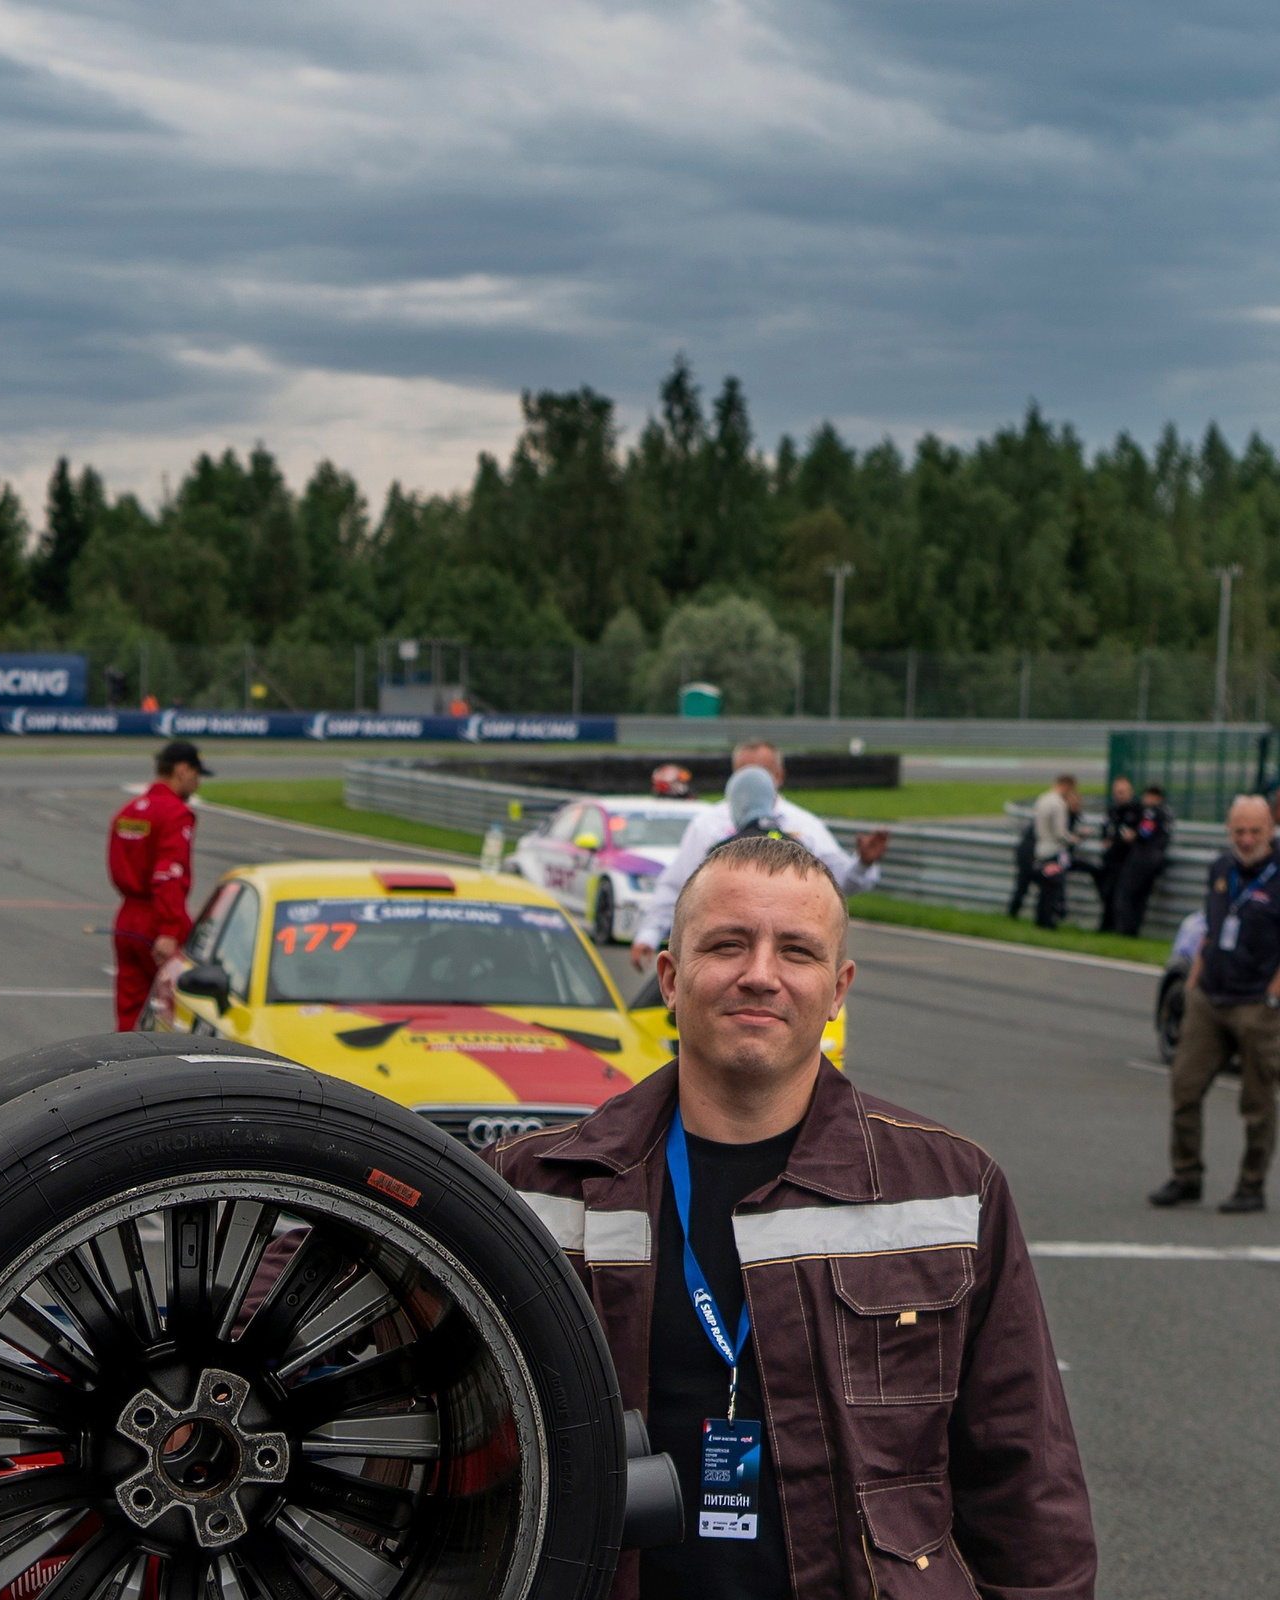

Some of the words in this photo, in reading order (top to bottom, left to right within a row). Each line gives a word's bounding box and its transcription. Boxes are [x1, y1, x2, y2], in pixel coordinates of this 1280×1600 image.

[380, 908, 424, 921] SMP
[427, 908, 502, 924] RACING
[276, 922, 357, 954] 177
[700, 1303, 715, 1326] SMP
[710, 1326, 735, 1362] RACING
[704, 1493, 750, 1507] ПИТЛЕЙН
